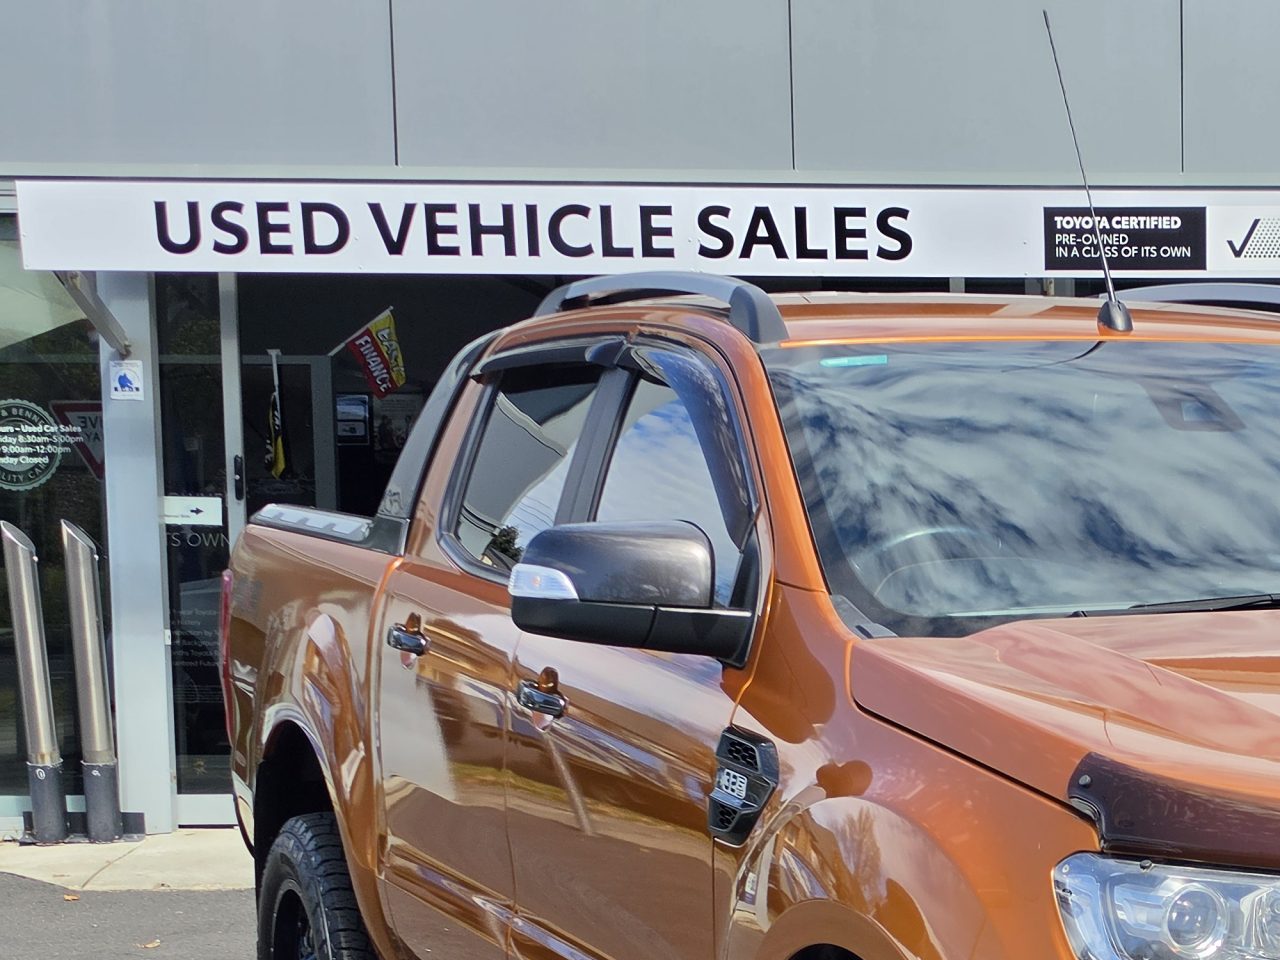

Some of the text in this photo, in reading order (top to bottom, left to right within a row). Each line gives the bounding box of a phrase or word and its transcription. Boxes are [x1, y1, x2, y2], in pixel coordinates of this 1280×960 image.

[1054, 216, 1182, 229] TOYOTA CERTIFIED
[154, 200, 913, 261] USED VEHICLE SALES
[1055, 233, 1129, 245] PRE-OWNED
[1055, 246, 1068, 258] IN
[1070, 246, 1079, 258] A
[1121, 246, 1138, 258] OF
[1141, 246, 1157, 258] ITS
[1160, 246, 1191, 258] OWN
[354, 335, 392, 393] FINANCE
[60, 424, 82, 432] Sales
[19, 456, 50, 464] Closed
